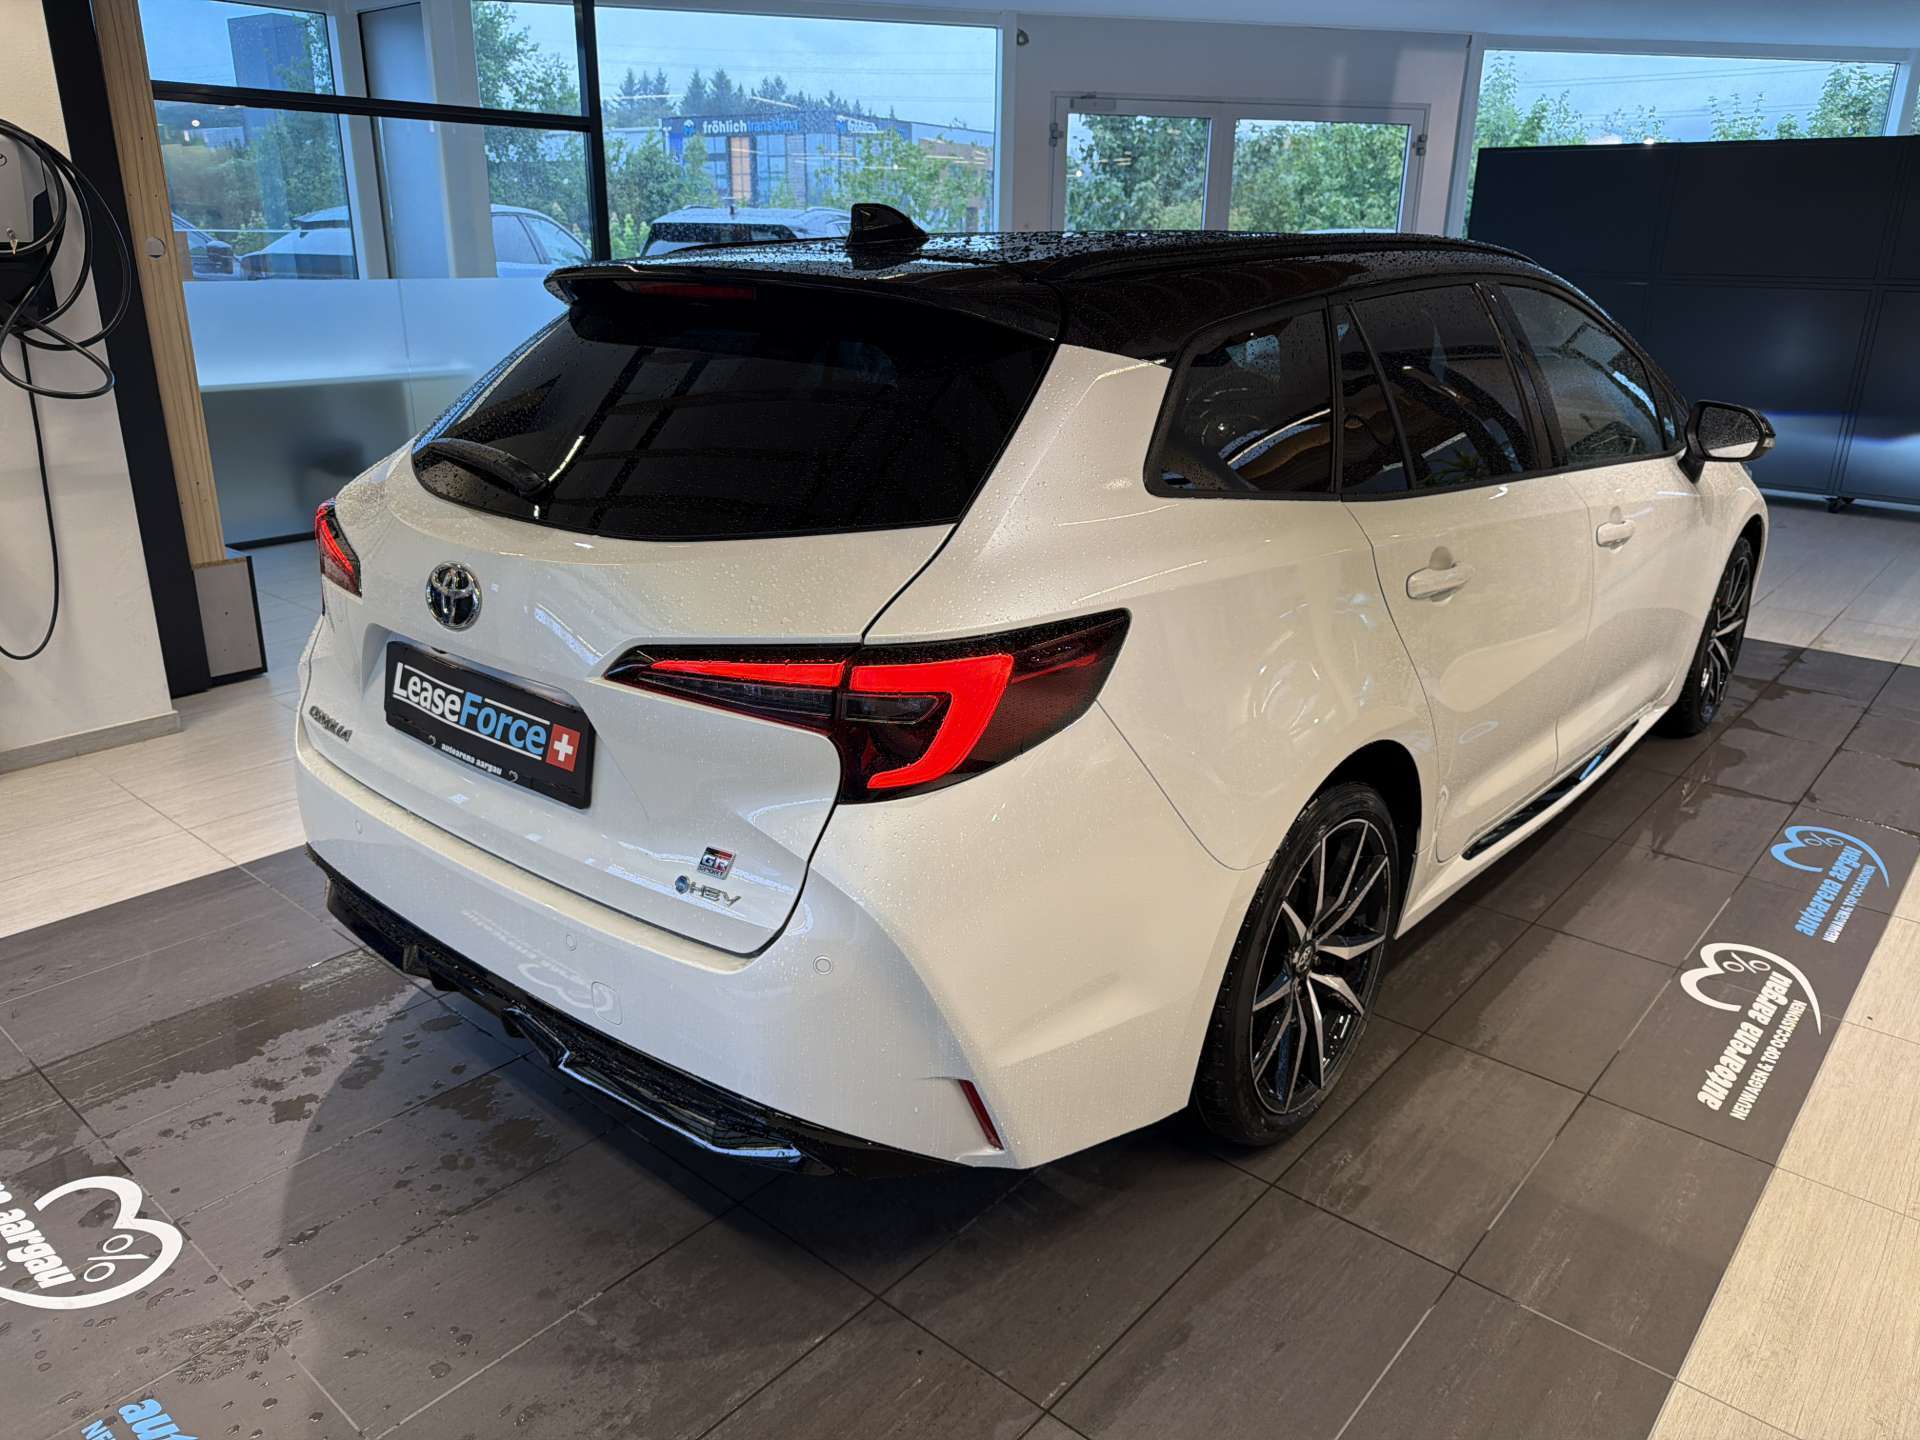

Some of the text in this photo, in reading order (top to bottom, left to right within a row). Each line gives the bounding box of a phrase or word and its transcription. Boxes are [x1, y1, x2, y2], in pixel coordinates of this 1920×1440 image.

[393, 662, 547, 756] LeaseForce
[441, 743, 503, 776] autoarena aargau
[701, 855, 730, 873] GR
[690, 881, 741, 907] HEV
[1795, 845, 1863, 937] autoarena aargau
[1697, 970, 1793, 1111] autoarena aargau
[1769, 999, 1808, 1049] OCCASIONEN
[1760, 1045, 1782, 1064] TOP
[1729, 1068, 1771, 1121] NEUWAGEN
[0, 1208, 77, 1289] aargau
